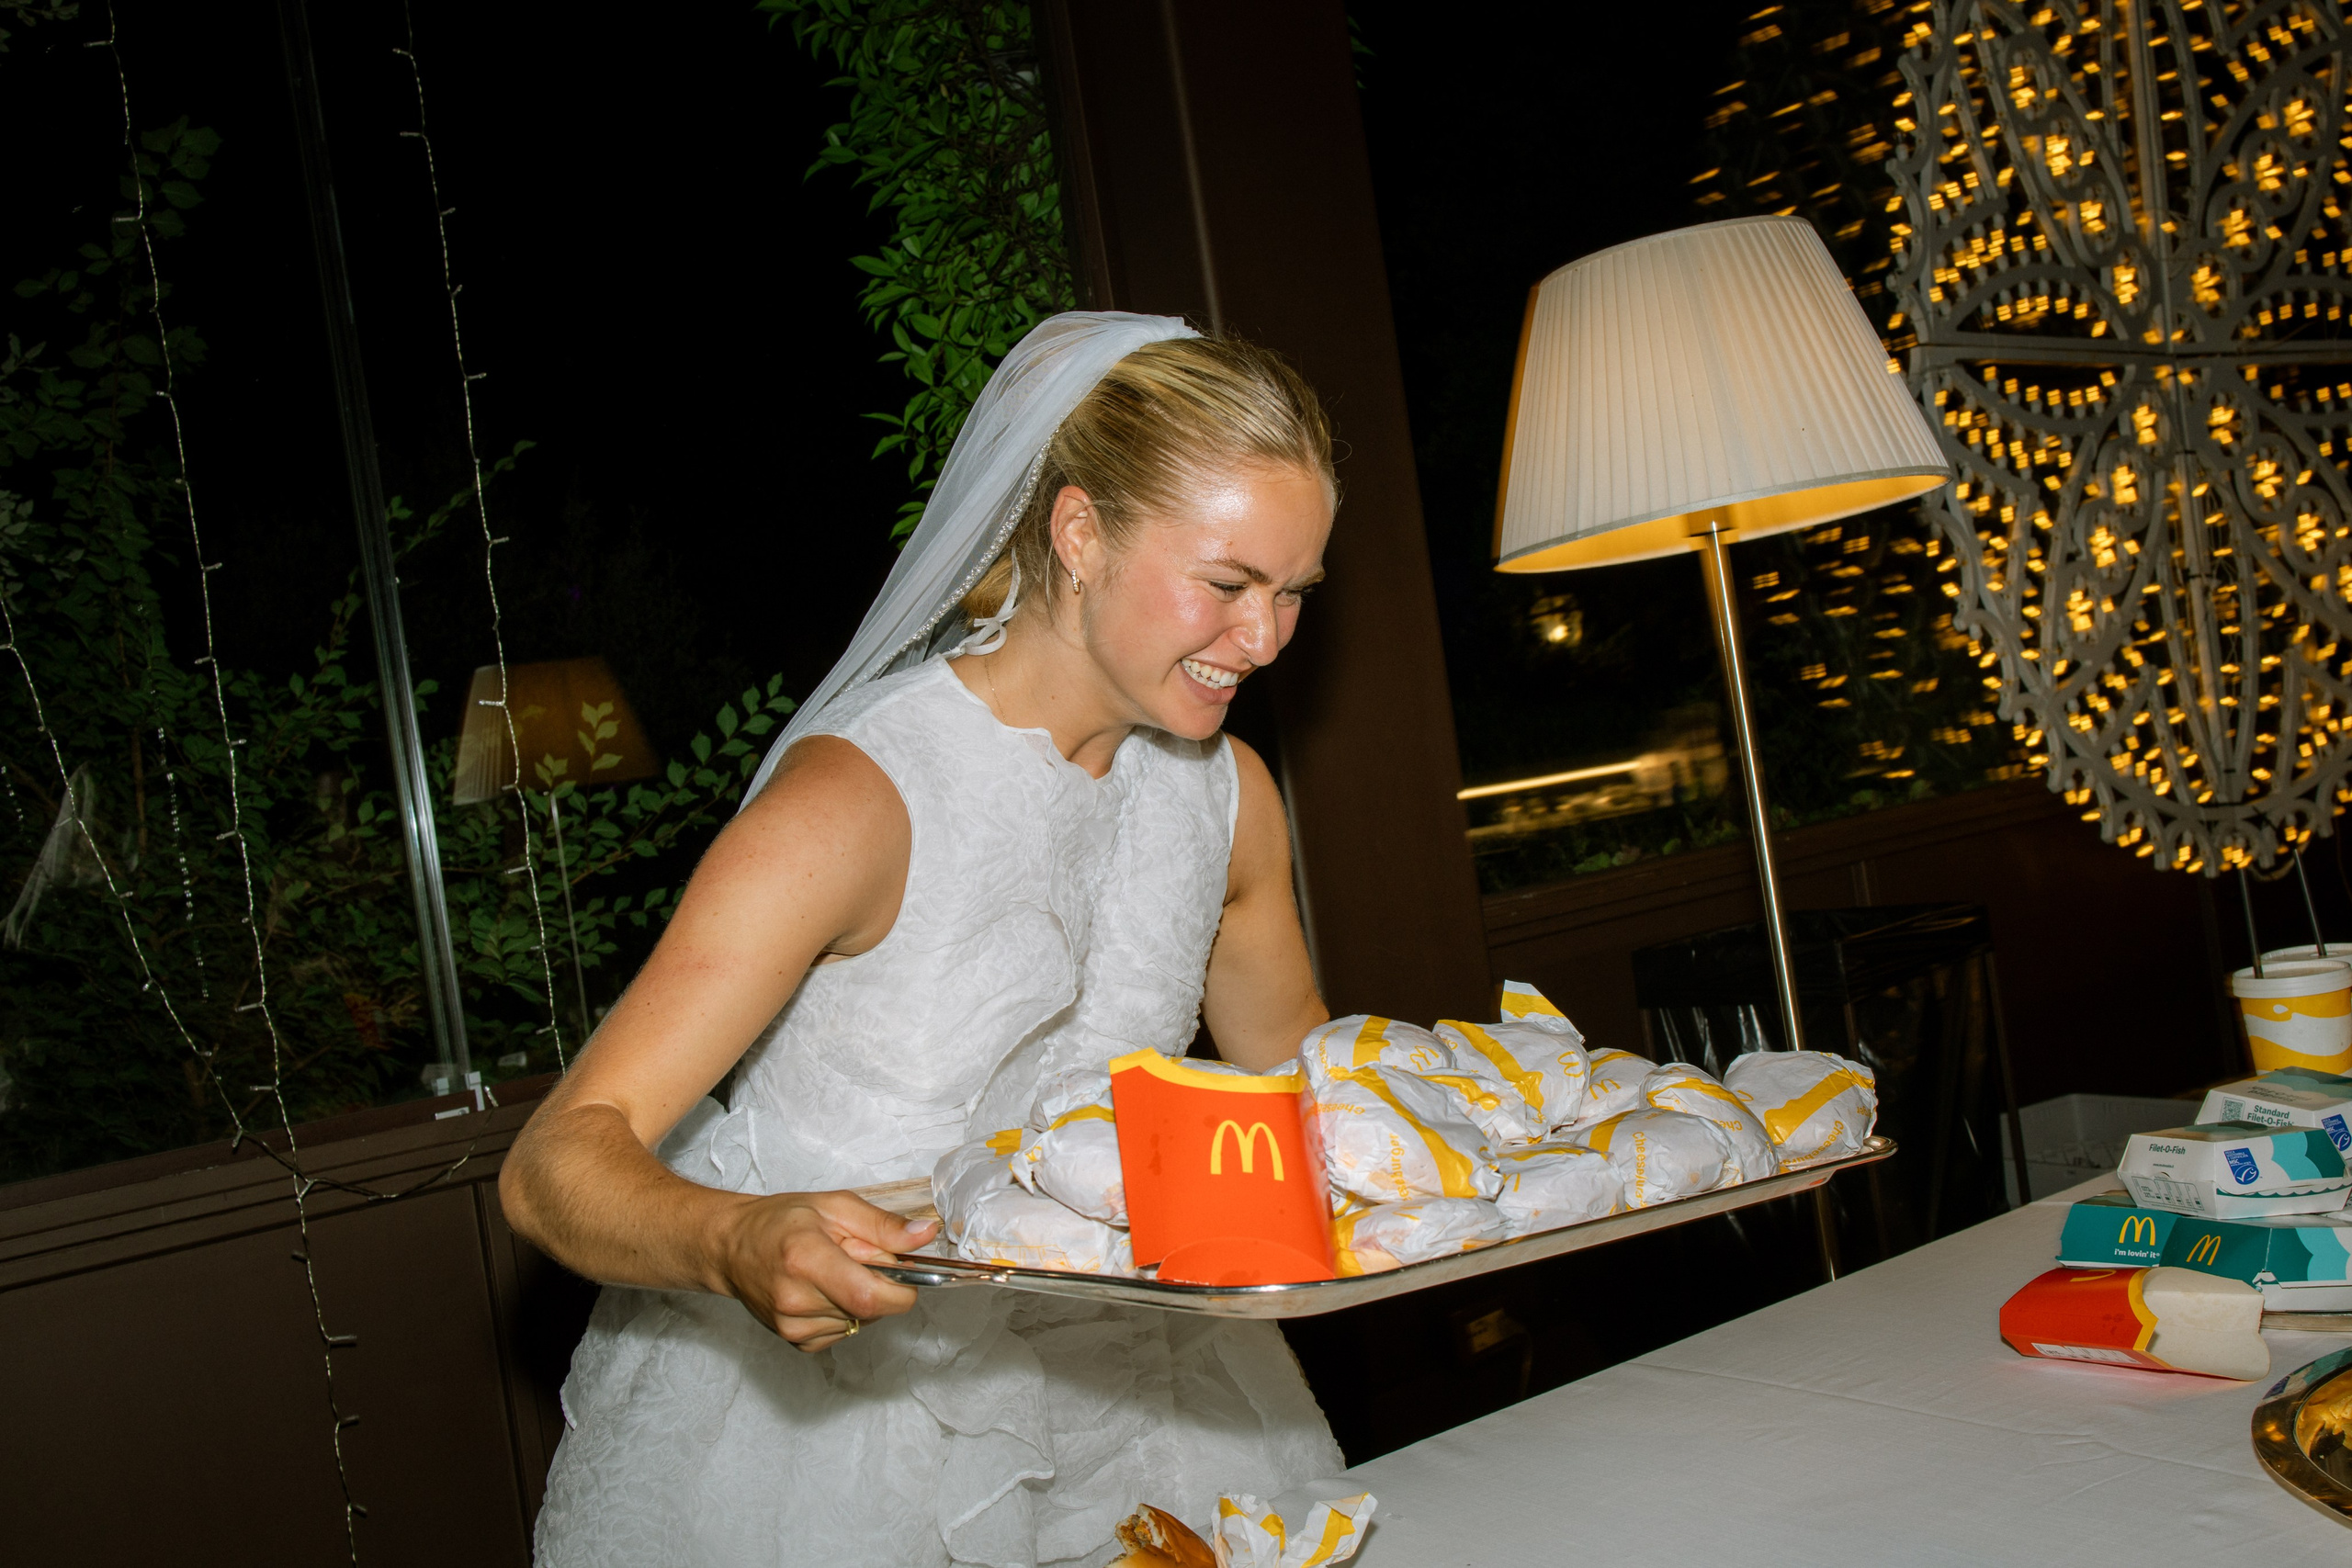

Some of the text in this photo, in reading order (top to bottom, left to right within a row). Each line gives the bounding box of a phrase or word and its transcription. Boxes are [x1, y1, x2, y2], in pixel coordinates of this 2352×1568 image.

[2254, 1104, 2290, 1119] Standard
[1780, 1120, 1845, 1166] Cheeseburg
[2148, 1143, 2187, 1156] Filet-O-Fish
[2114, 1247, 2127, 1257] i'm
[2127, 1249, 2150, 1258] lovin'
